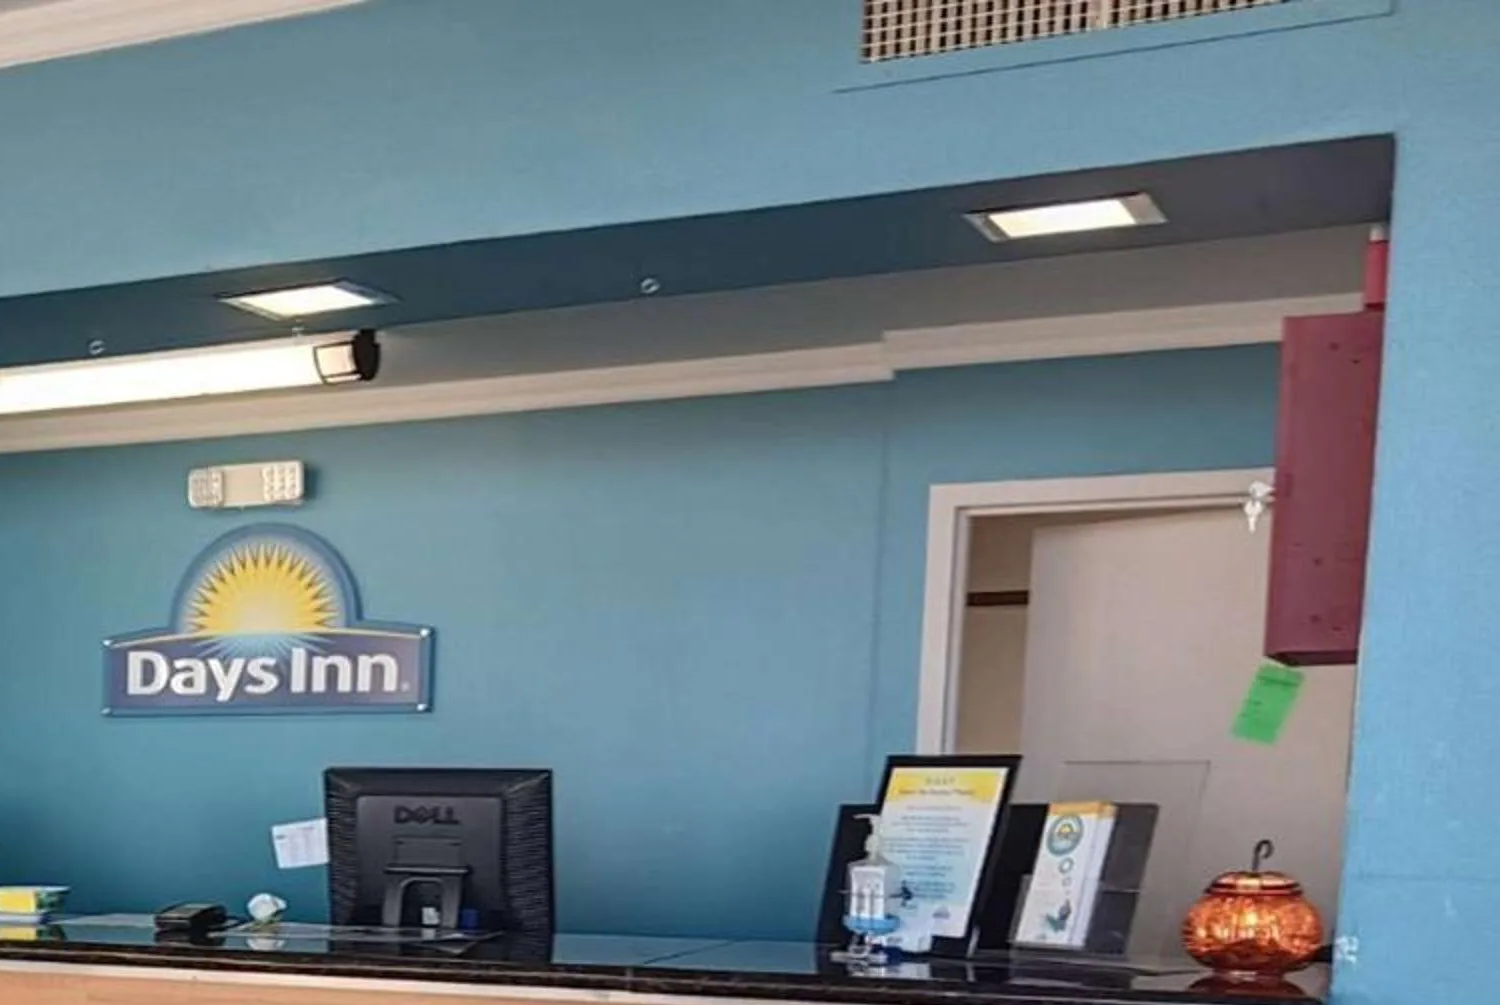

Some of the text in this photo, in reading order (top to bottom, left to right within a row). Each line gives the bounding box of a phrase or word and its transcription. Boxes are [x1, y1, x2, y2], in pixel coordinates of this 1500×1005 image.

[127, 647, 398, 702] Days Inn
[393, 804, 460, 825] DELL
